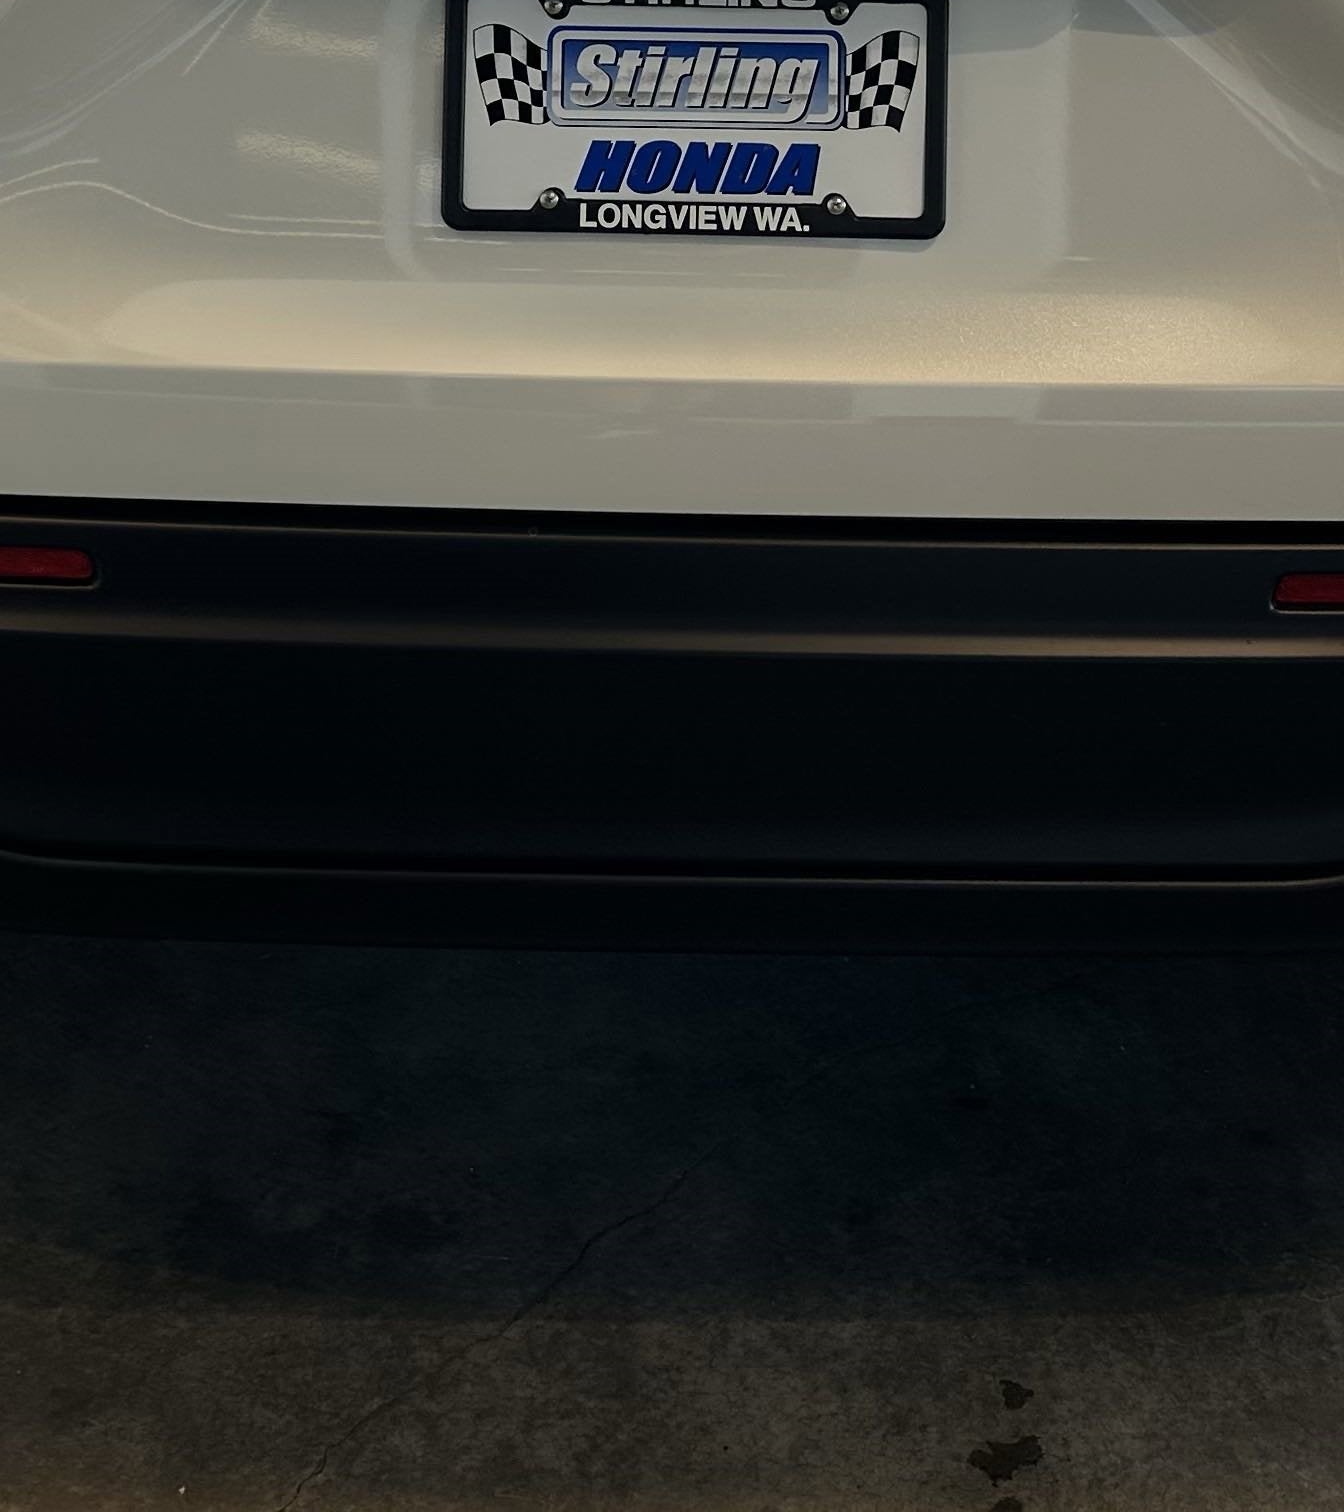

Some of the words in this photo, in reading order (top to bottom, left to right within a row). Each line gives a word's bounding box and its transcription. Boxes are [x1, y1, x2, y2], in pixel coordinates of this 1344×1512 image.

[570, 43, 819, 124] Stirling
[574, 140, 821, 196] HONDA
[579, 202, 747, 231] LONGVIEW
[753, 206, 810, 232] WA.
